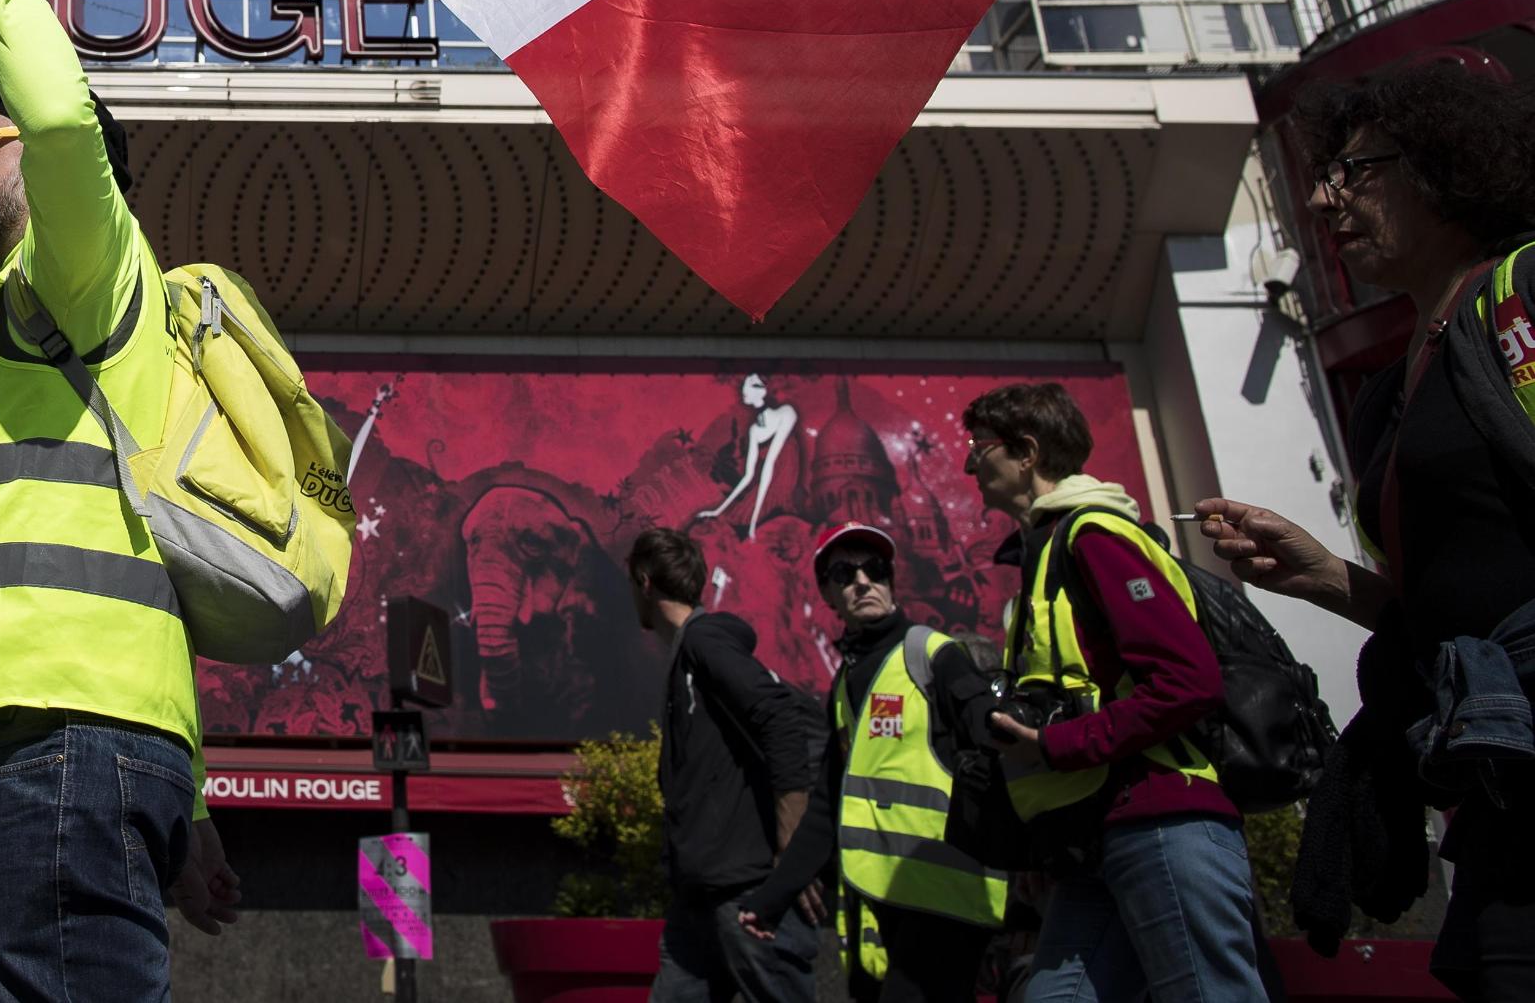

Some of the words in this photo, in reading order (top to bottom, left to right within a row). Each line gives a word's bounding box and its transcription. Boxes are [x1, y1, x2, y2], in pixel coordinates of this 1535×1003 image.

[301, 472, 356, 515] DUC
[869, 713, 904, 738] cgt
[295, 779, 381, 800] ROUGE
